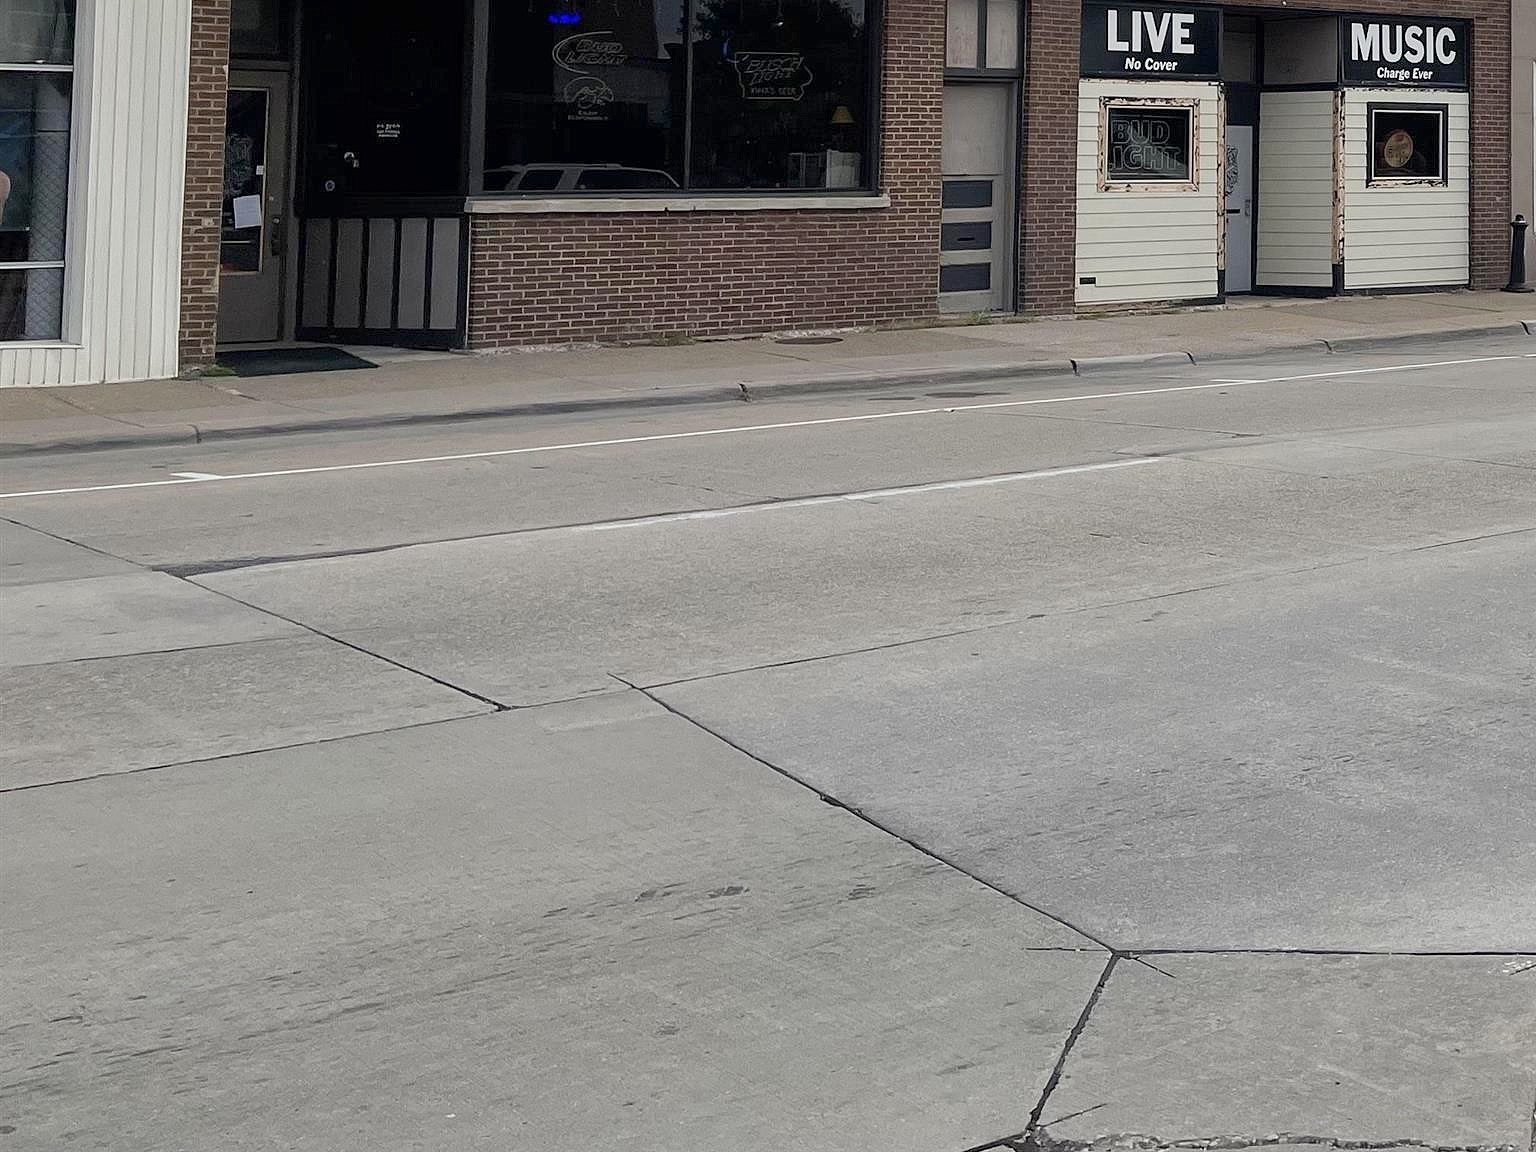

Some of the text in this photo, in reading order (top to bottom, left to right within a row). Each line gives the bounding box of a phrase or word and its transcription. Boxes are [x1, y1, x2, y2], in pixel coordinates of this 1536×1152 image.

[1107, 9, 1195, 54] LIVE
[1351, 22, 1457, 65] MUSIC
[1125, 57, 1178, 71] No Cover
[1376, 67, 1434, 80] Charge Ever
[1111, 120, 1170, 144] BUD
[1109, 144, 1182, 170] IGHT
